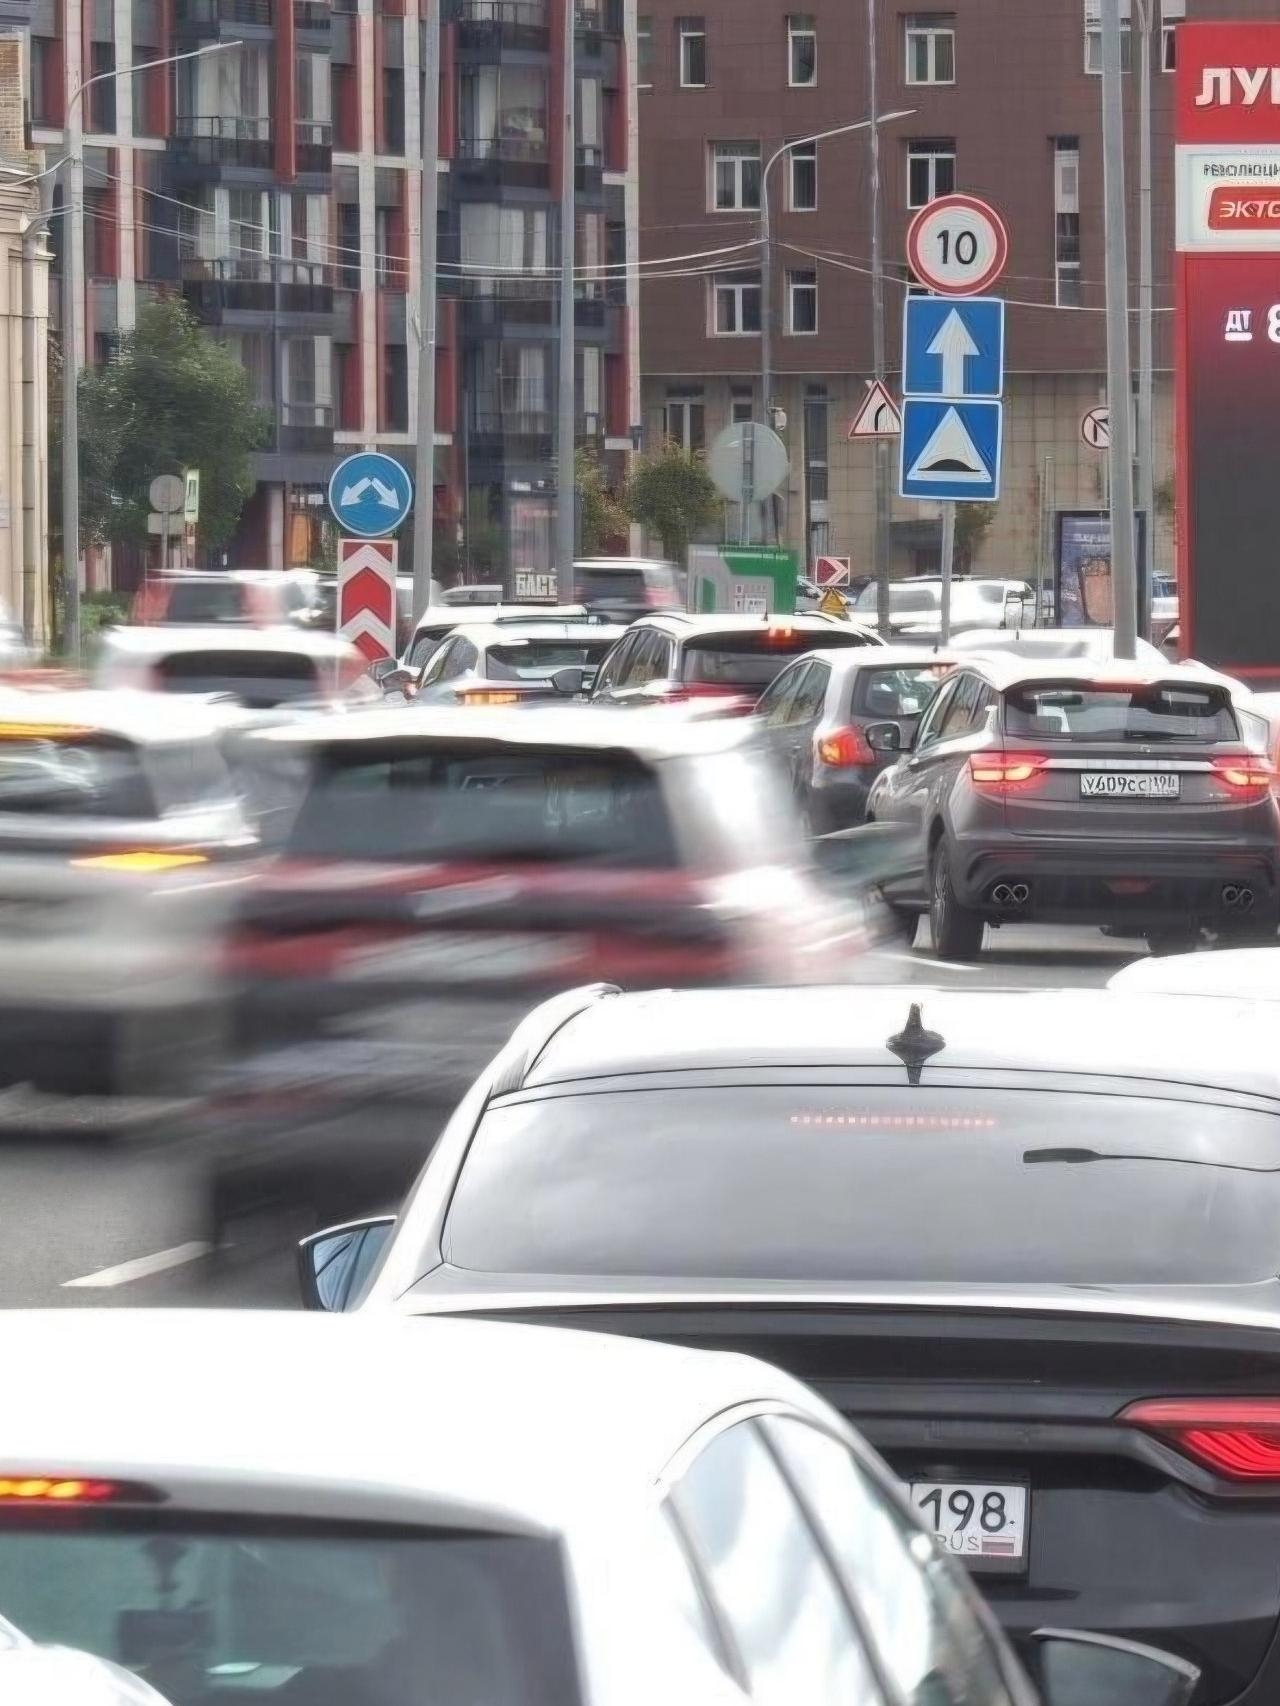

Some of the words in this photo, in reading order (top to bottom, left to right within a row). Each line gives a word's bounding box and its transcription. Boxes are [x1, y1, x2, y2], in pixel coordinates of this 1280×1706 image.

[936, 229, 978, 266] 10
[1225, 310, 1252, 333] ДТ
[918, 1488, 1007, 1533] 198
